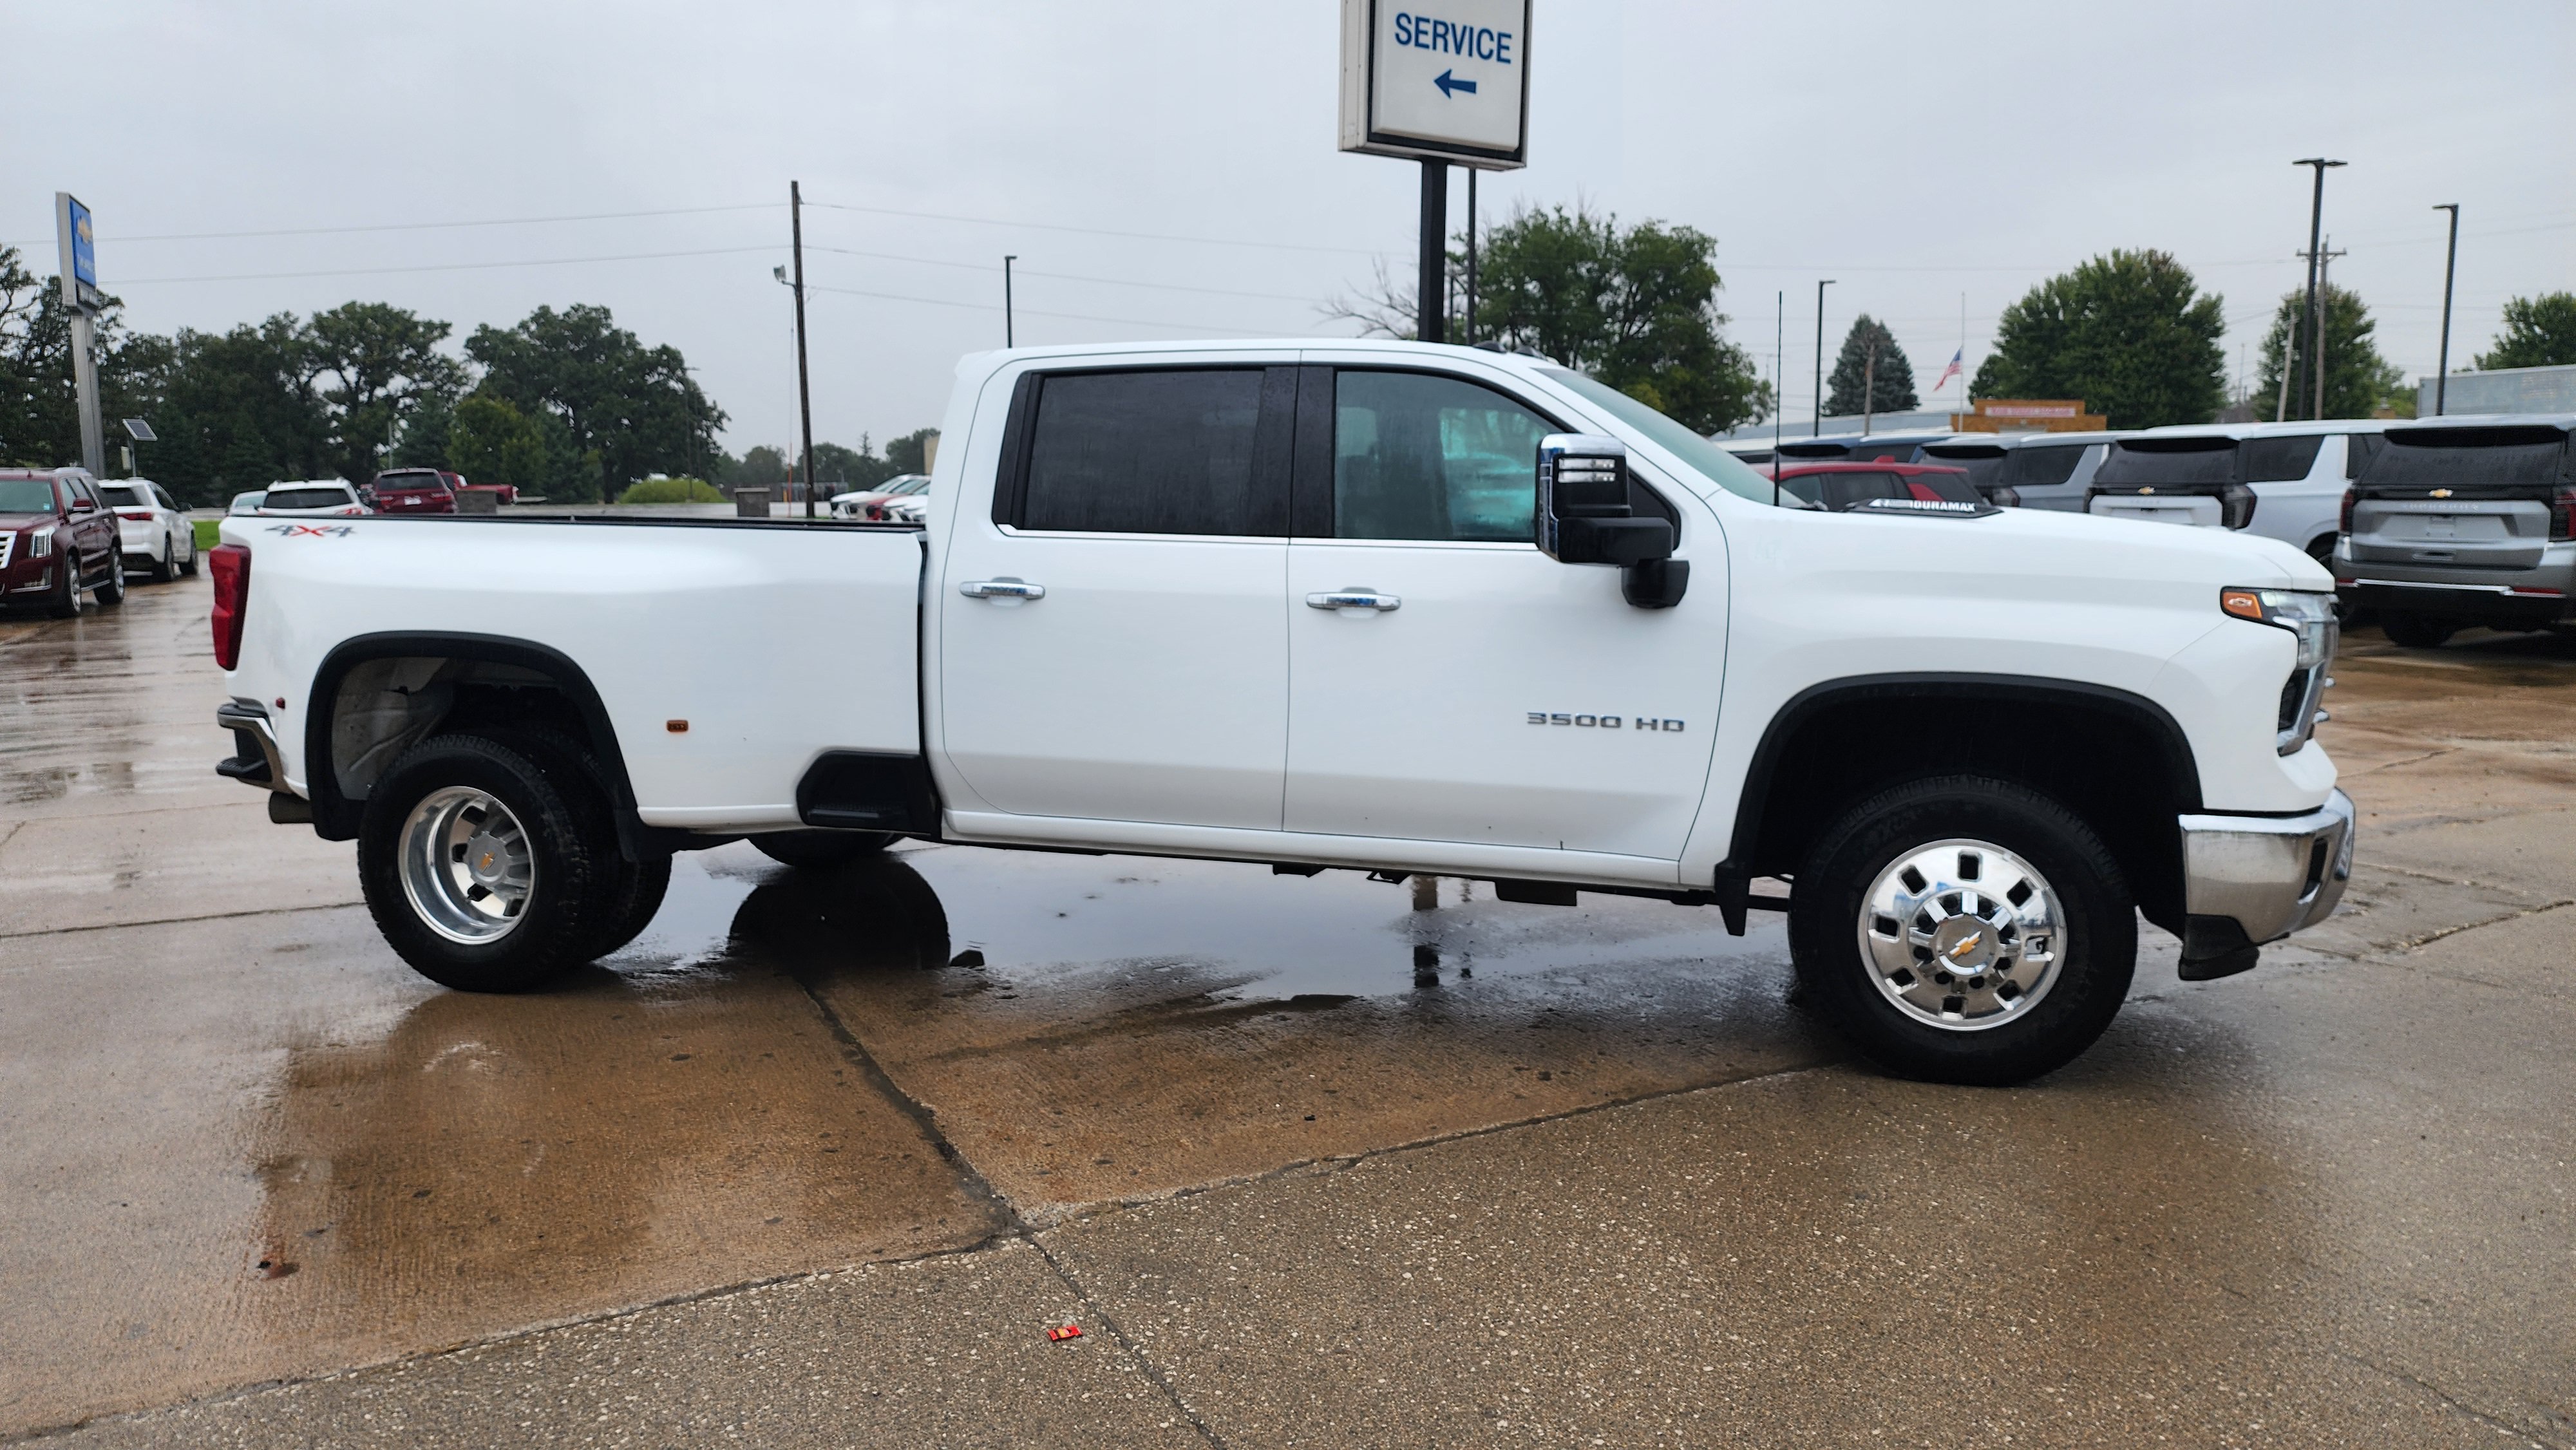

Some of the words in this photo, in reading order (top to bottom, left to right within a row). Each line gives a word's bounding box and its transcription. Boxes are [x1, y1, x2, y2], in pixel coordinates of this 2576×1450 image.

[1394, 12, 1513, 64] SERVICE
[1914, 500, 1976, 513] DURAMAX
[1527, 711, 1622, 728] 3500
[1635, 717, 1685, 732] HD
